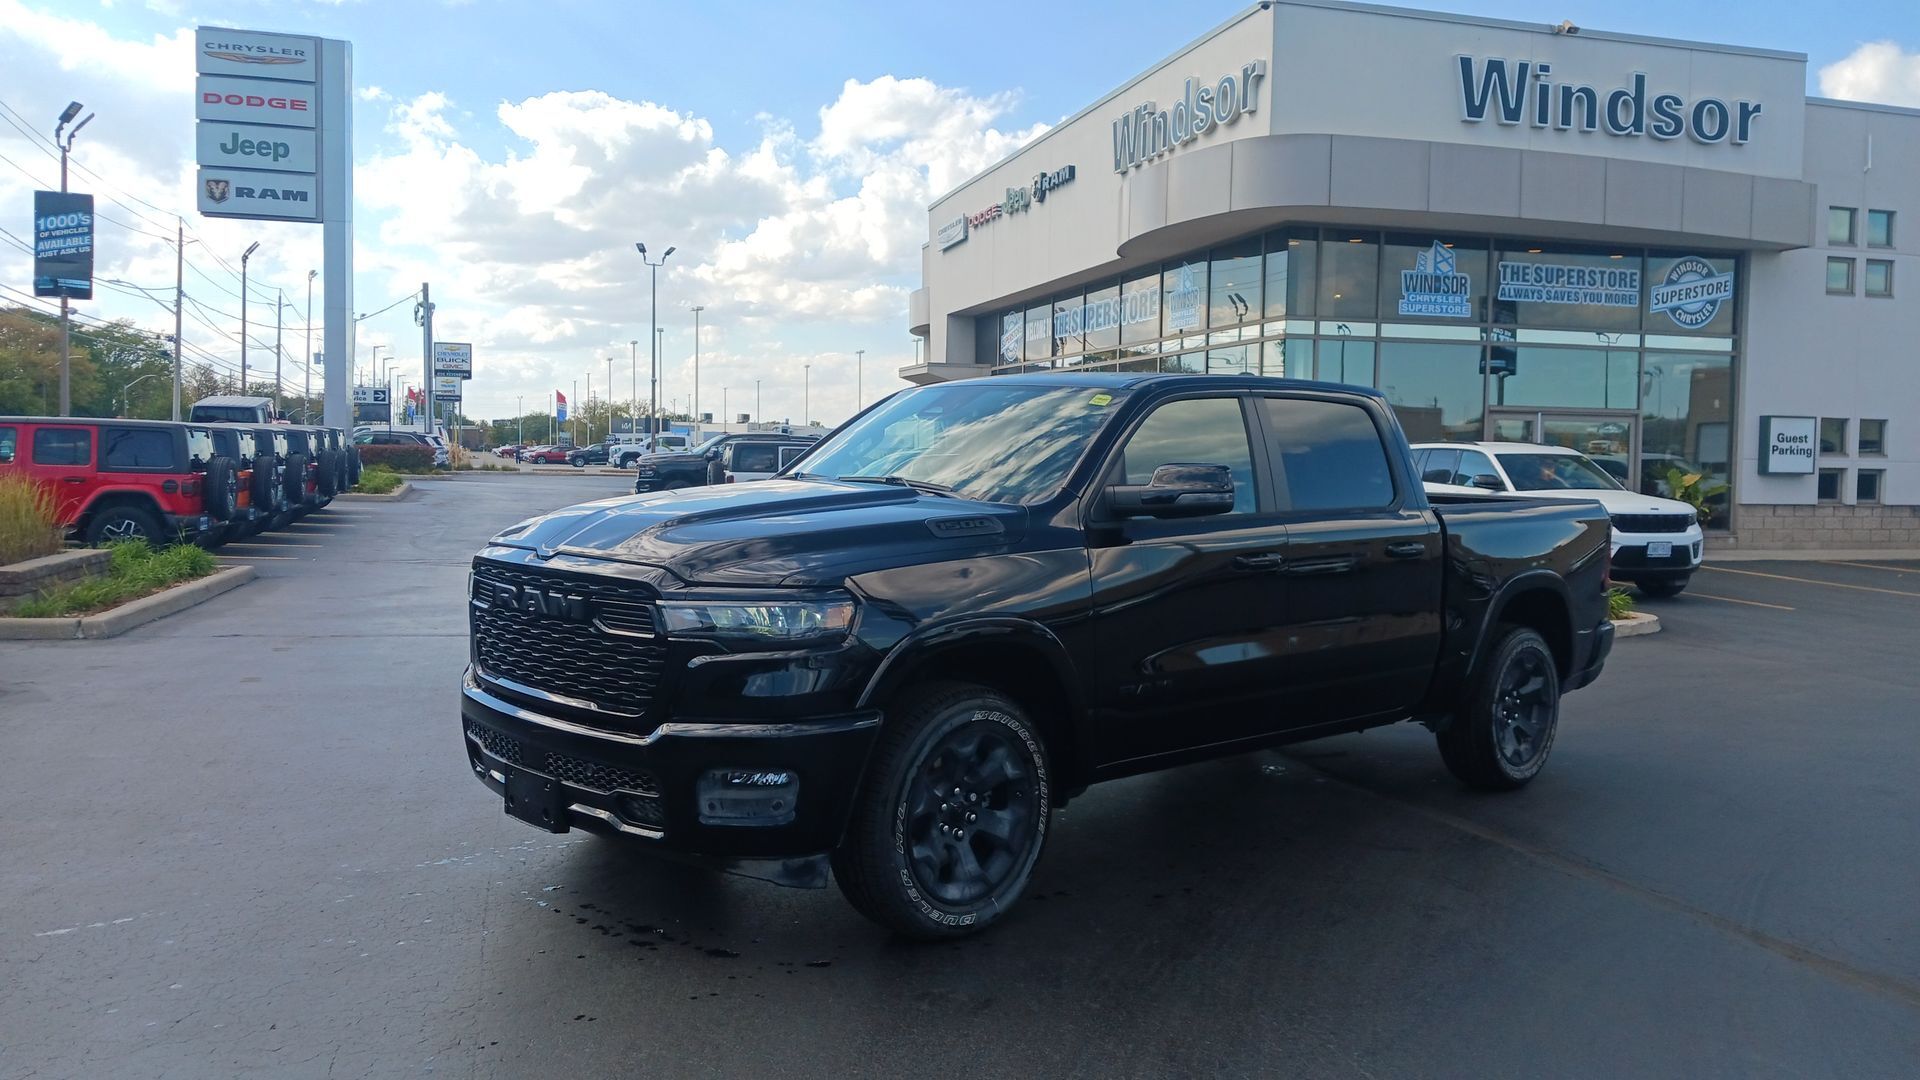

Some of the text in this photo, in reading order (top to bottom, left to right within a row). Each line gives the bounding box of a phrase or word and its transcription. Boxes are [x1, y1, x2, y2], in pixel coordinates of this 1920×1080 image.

[204, 42, 305, 57] CHRYSLER
[203, 93, 308, 111] DODGE
[1457, 54, 1763, 145] Windsor
[1112, 58, 1266, 174] Windsor
[219, 132, 290, 162] Jeep
[1042, 165, 1075, 191] RAM
[235, 186, 308, 202] RAM
[968, 203, 1002, 227] DODGE
[51, 227, 89, 237] VEHICLES
[38, 235, 92, 251] AVAILABLE
[38, 249, 58, 258] JUST
[60, 247, 78, 255] ASK
[1501, 264, 1638, 289] THE SUPERSTORE
[1670, 261, 1709, 281] WINDSOR
[1404, 273, 1468, 295] WINDSOR
[1653, 280, 1730, 306] SUPERSTORE
[1409, 294, 1462, 304] CHRYSLER
[1500, 287, 1637, 305] ALWAYS SAVES YOU MORE!
[1055, 314, 1069, 338] THE
[1071, 290, 1159, 335] SUPERSTORE
[1402, 303, 1469, 314] SUPERSTORE
[1676, 303, 1713, 324] CHRYSLER
[1777, 432, 1808, 443] Guest
[1771, 445, 1812, 458] Parking
[935, 519, 990, 531] 1500
[492, 582, 586, 619] RAM
[971, 710, 1048, 835] BRIDGESTONE
[900, 868, 977, 926] DUELER
